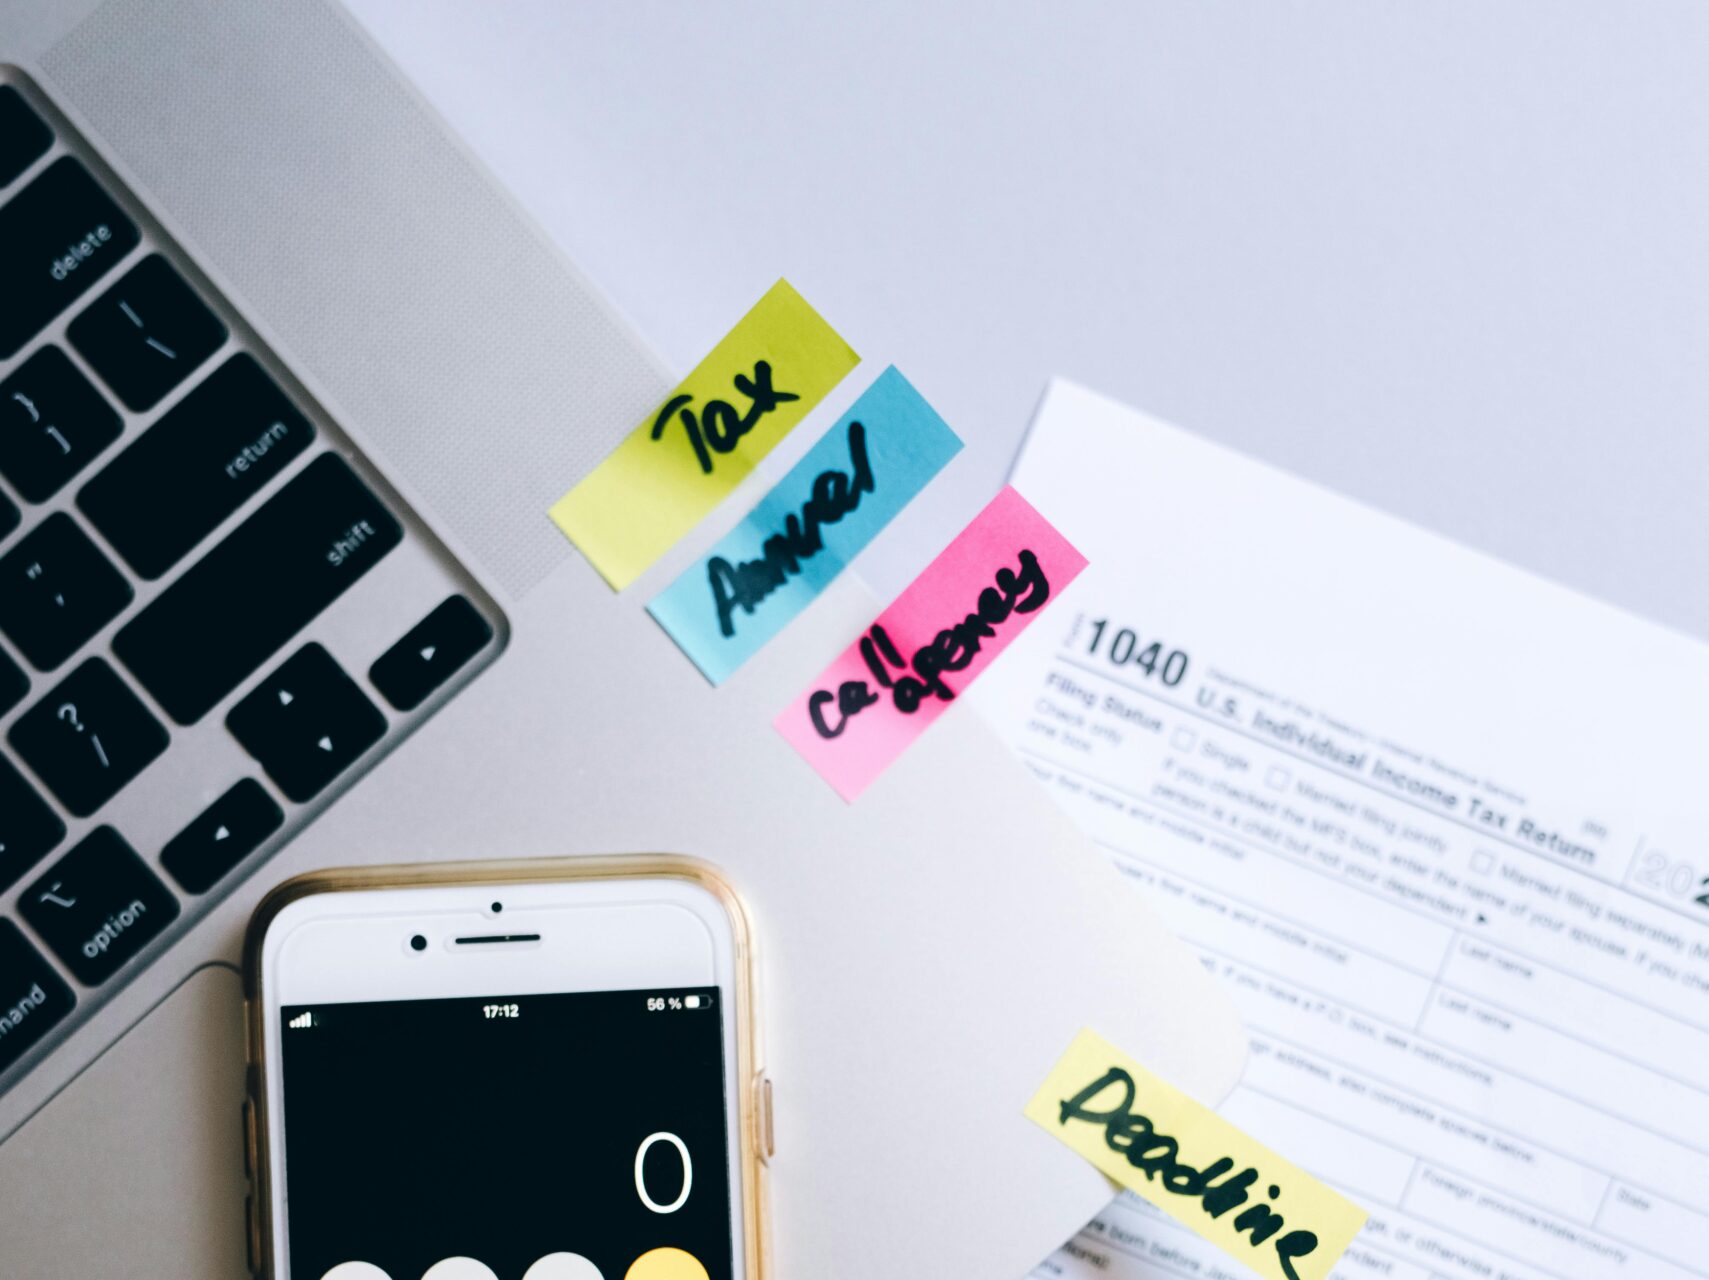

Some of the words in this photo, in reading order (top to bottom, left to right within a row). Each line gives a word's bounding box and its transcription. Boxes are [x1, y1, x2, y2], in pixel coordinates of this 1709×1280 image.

[50, 224, 112, 281] delete
[652, 360, 800, 474] Tax
[225, 420, 289, 479] return
[326, 519, 376, 566] shift
[1087, 619, 1189, 687] 1040
[57, 703, 85, 732] ?
[1044, 670, 1098, 709] Filing
[1101, 694, 1163, 733] Status
[1194, 685, 1240, 722] U.S.
[1251, 709, 1368, 771] Individual
[1371, 758, 1459, 810] Income
[1468, 796, 1508, 829] Tax
[1515, 817, 1596, 864] Return
[82, 898, 147, 960] option
[483, 1004, 519, 1018] 17:12
[647, 998, 665, 1011] 56
[668, 997, 682, 1010] %
[634, 1131, 693, 1215] 0
